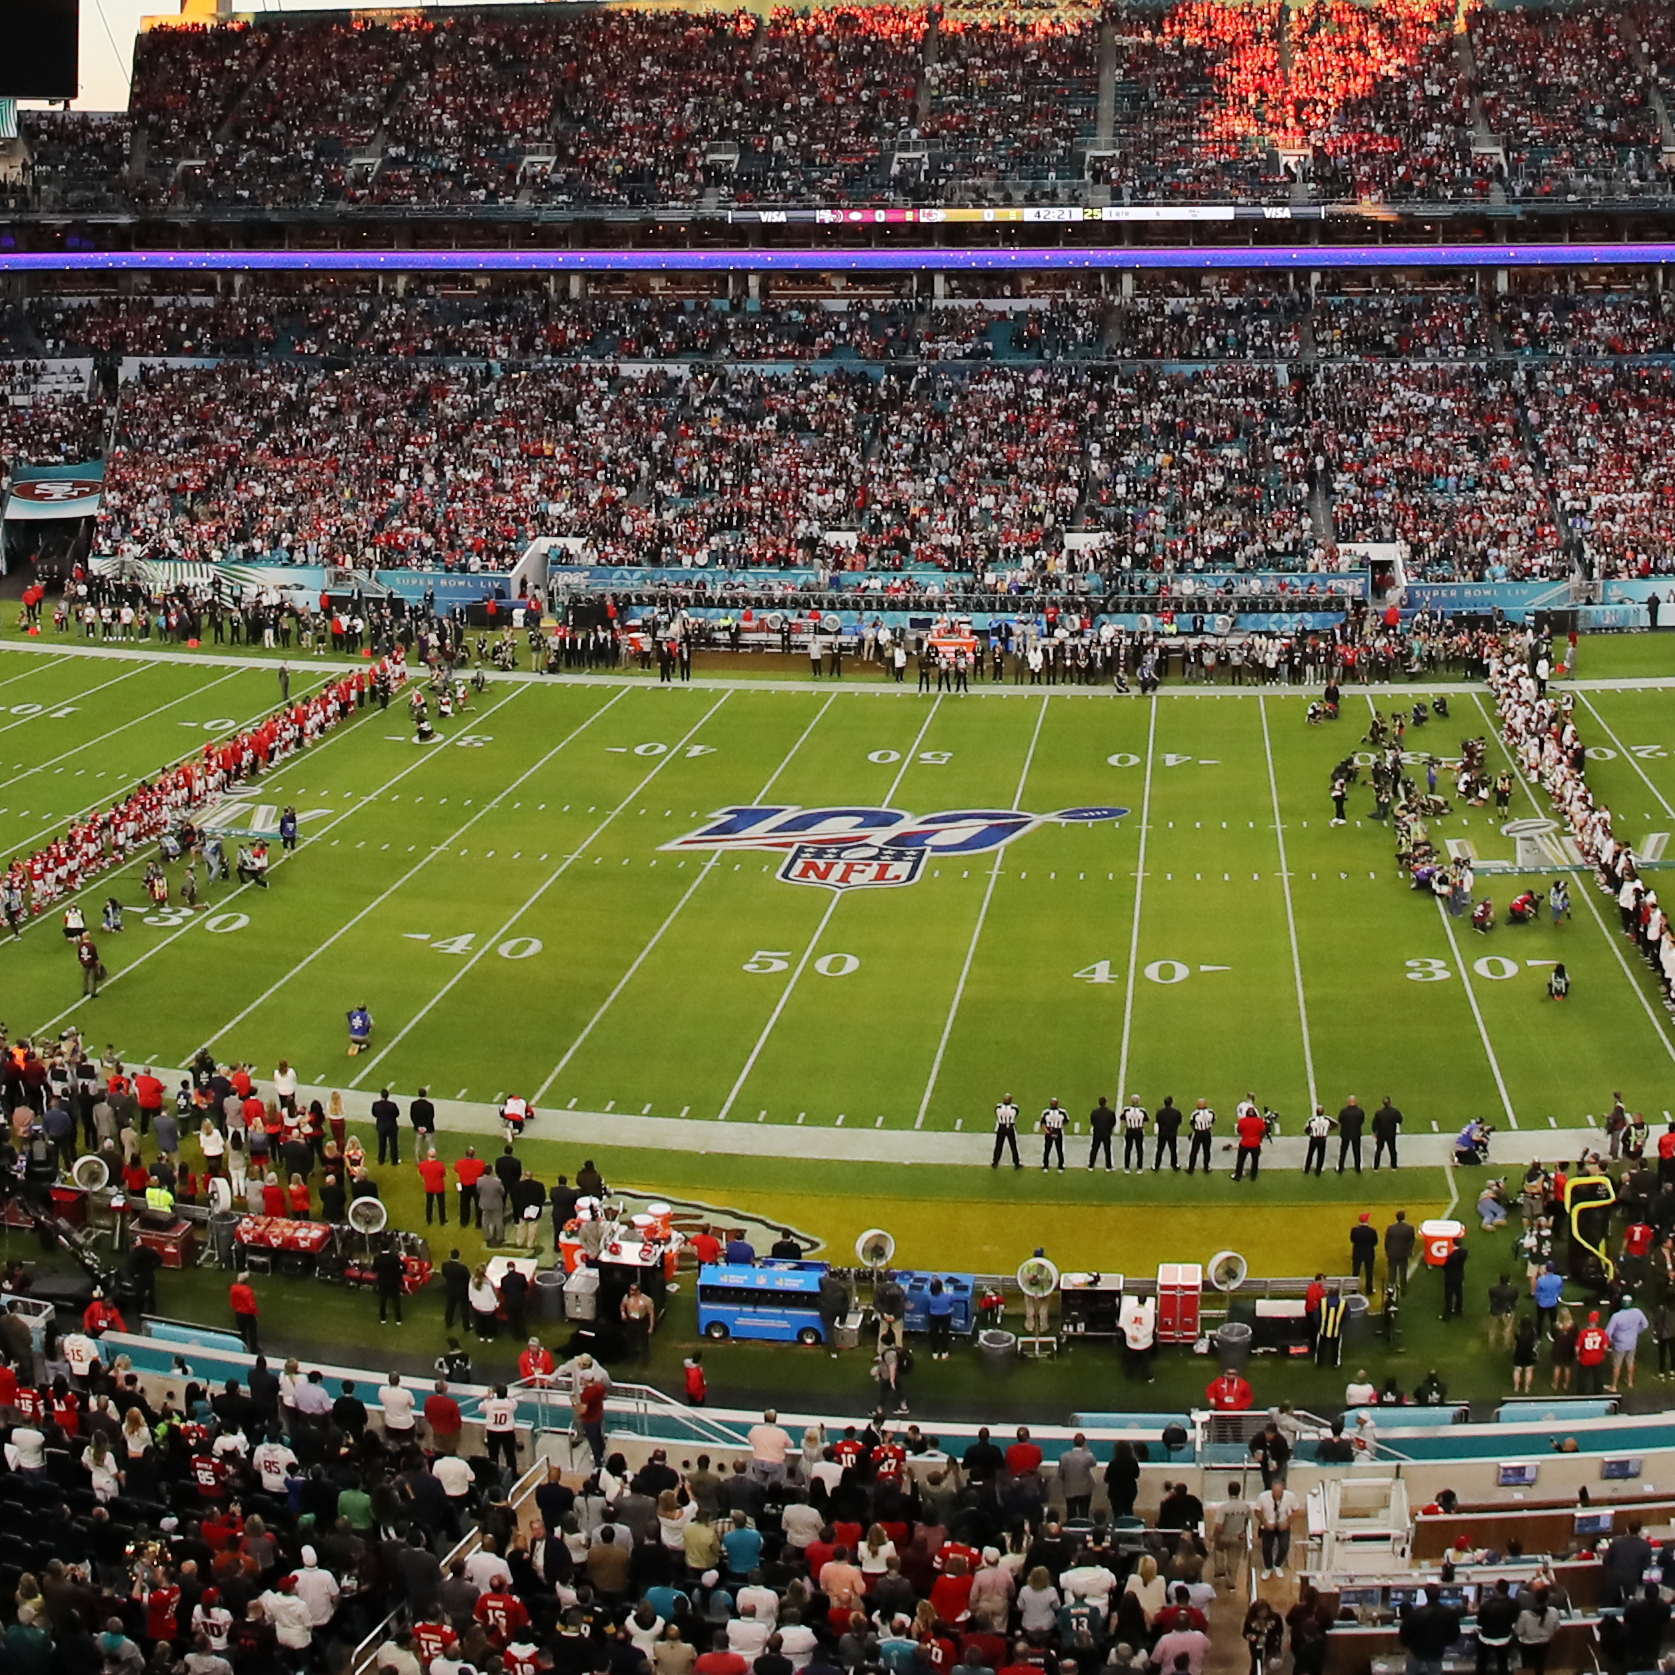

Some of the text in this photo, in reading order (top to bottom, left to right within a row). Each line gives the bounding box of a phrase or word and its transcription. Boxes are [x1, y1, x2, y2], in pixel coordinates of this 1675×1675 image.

[758, 211, 787, 222] VISA
[875, 210, 886, 222] 0
[1034, 209, 1074, 220] 42:21
[1083, 208, 1102, 220] 25
[1262, 207, 1291, 219] VISA
[395, 577, 501, 588] SUPER BOWL LIV
[1415, 588, 1528, 599] SUPER BOWL LIV
[10, 703, 83, 719] 10
[633, 742, 717, 758] 40
[867, 749, 954, 766] 50
[1107, 752, 1193, 768] 40
[794, 859, 904, 884] NFL
[143, 905, 250, 933] 30
[430, 932, 543, 960] 40
[742, 949, 861, 978] 50
[1405, 957, 1520, 982] 30
[1074, 959, 1190, 985] 40
[1430, 1241, 1448, 1257] G
[72, 1348, 83, 1362] 15
[20, 1398, 33, 1412] 15
[494, 1413, 507, 1425] 10
[264, 1459, 280, 1475] 85
[841, 1453, 856, 1468] 10
[196, 1469, 215, 1485] 85
[420, 1640, 443, 1657] 15
